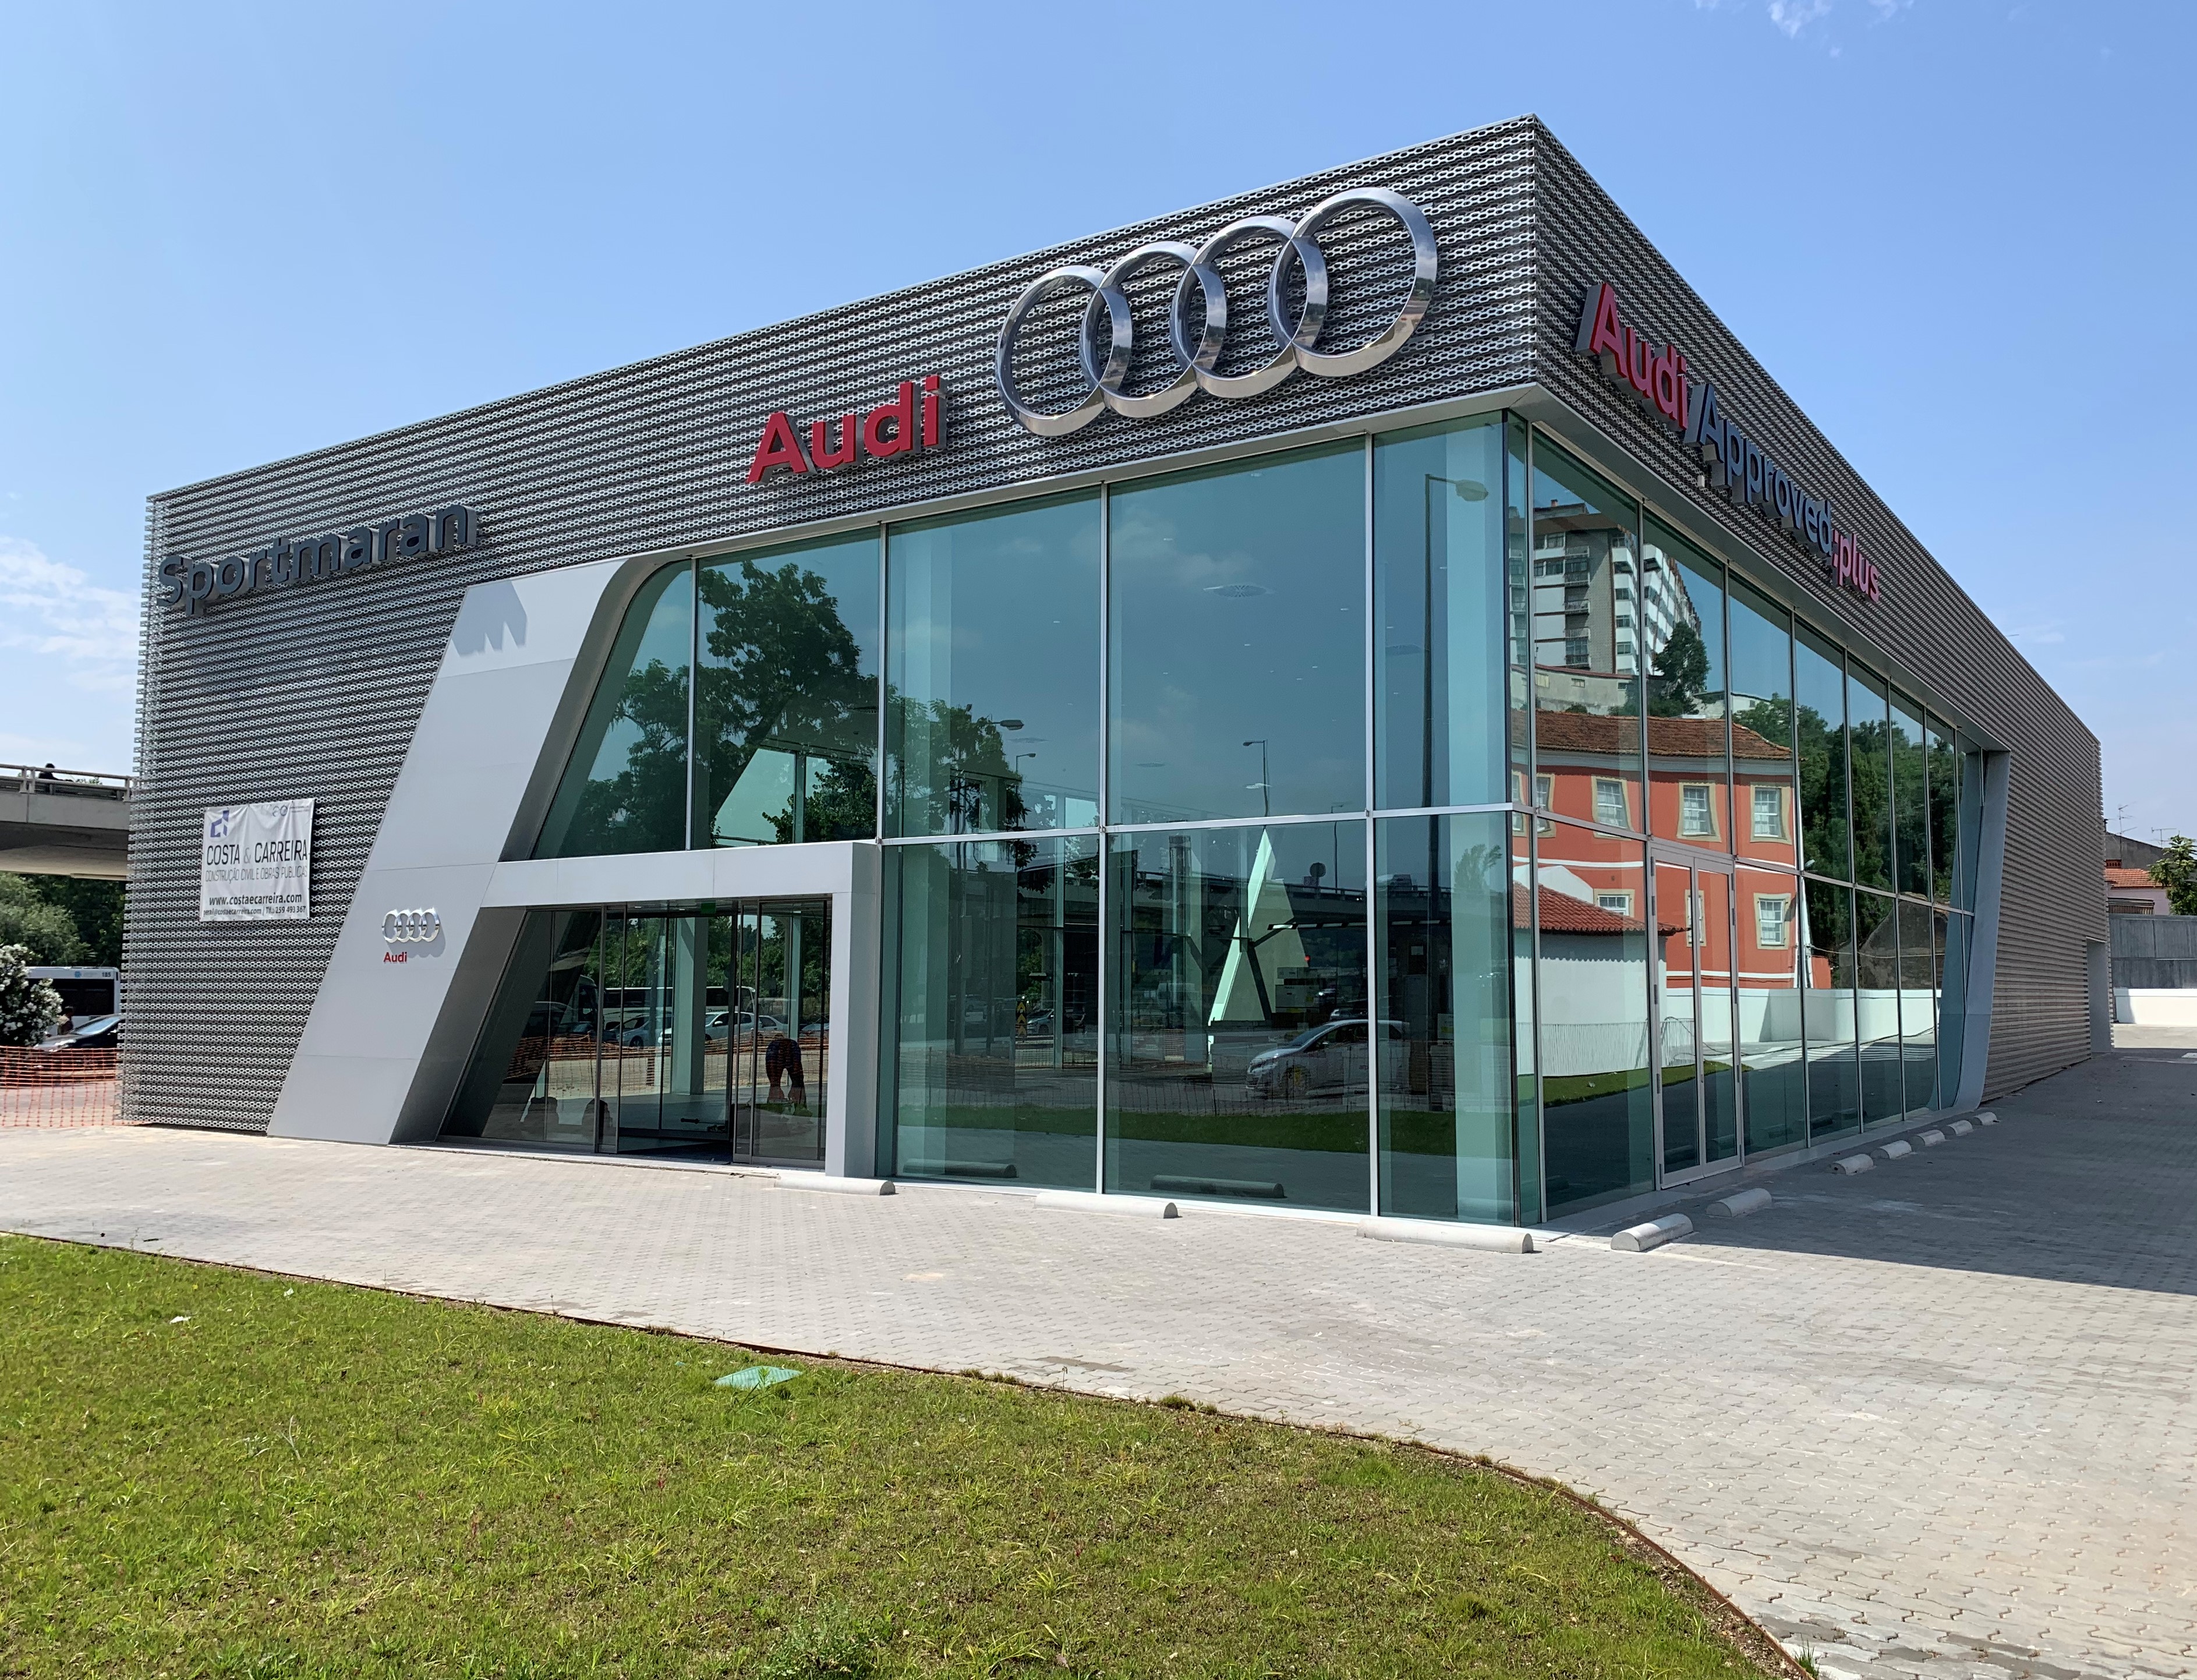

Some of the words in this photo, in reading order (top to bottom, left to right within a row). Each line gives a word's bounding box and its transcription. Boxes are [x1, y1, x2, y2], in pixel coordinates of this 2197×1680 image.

[745, 375, 942, 484] Audi
[1589, 283, 1688, 430] Audi
[1696, 384, 1832, 556] Approved
[157, 504, 469, 616] Sportmaran
[207, 844, 240, 865] COSTA
[243, 847, 252, 864] &
[254, 839, 307, 863] CARREIRA
[241, 868, 254, 880] CIVIL
[256, 868, 259, 879] E
[260, 866, 280, 879] OBRAS
[209, 892, 302, 906] www.costaecarreira.com
[383, 952, 408, 963] Audi
